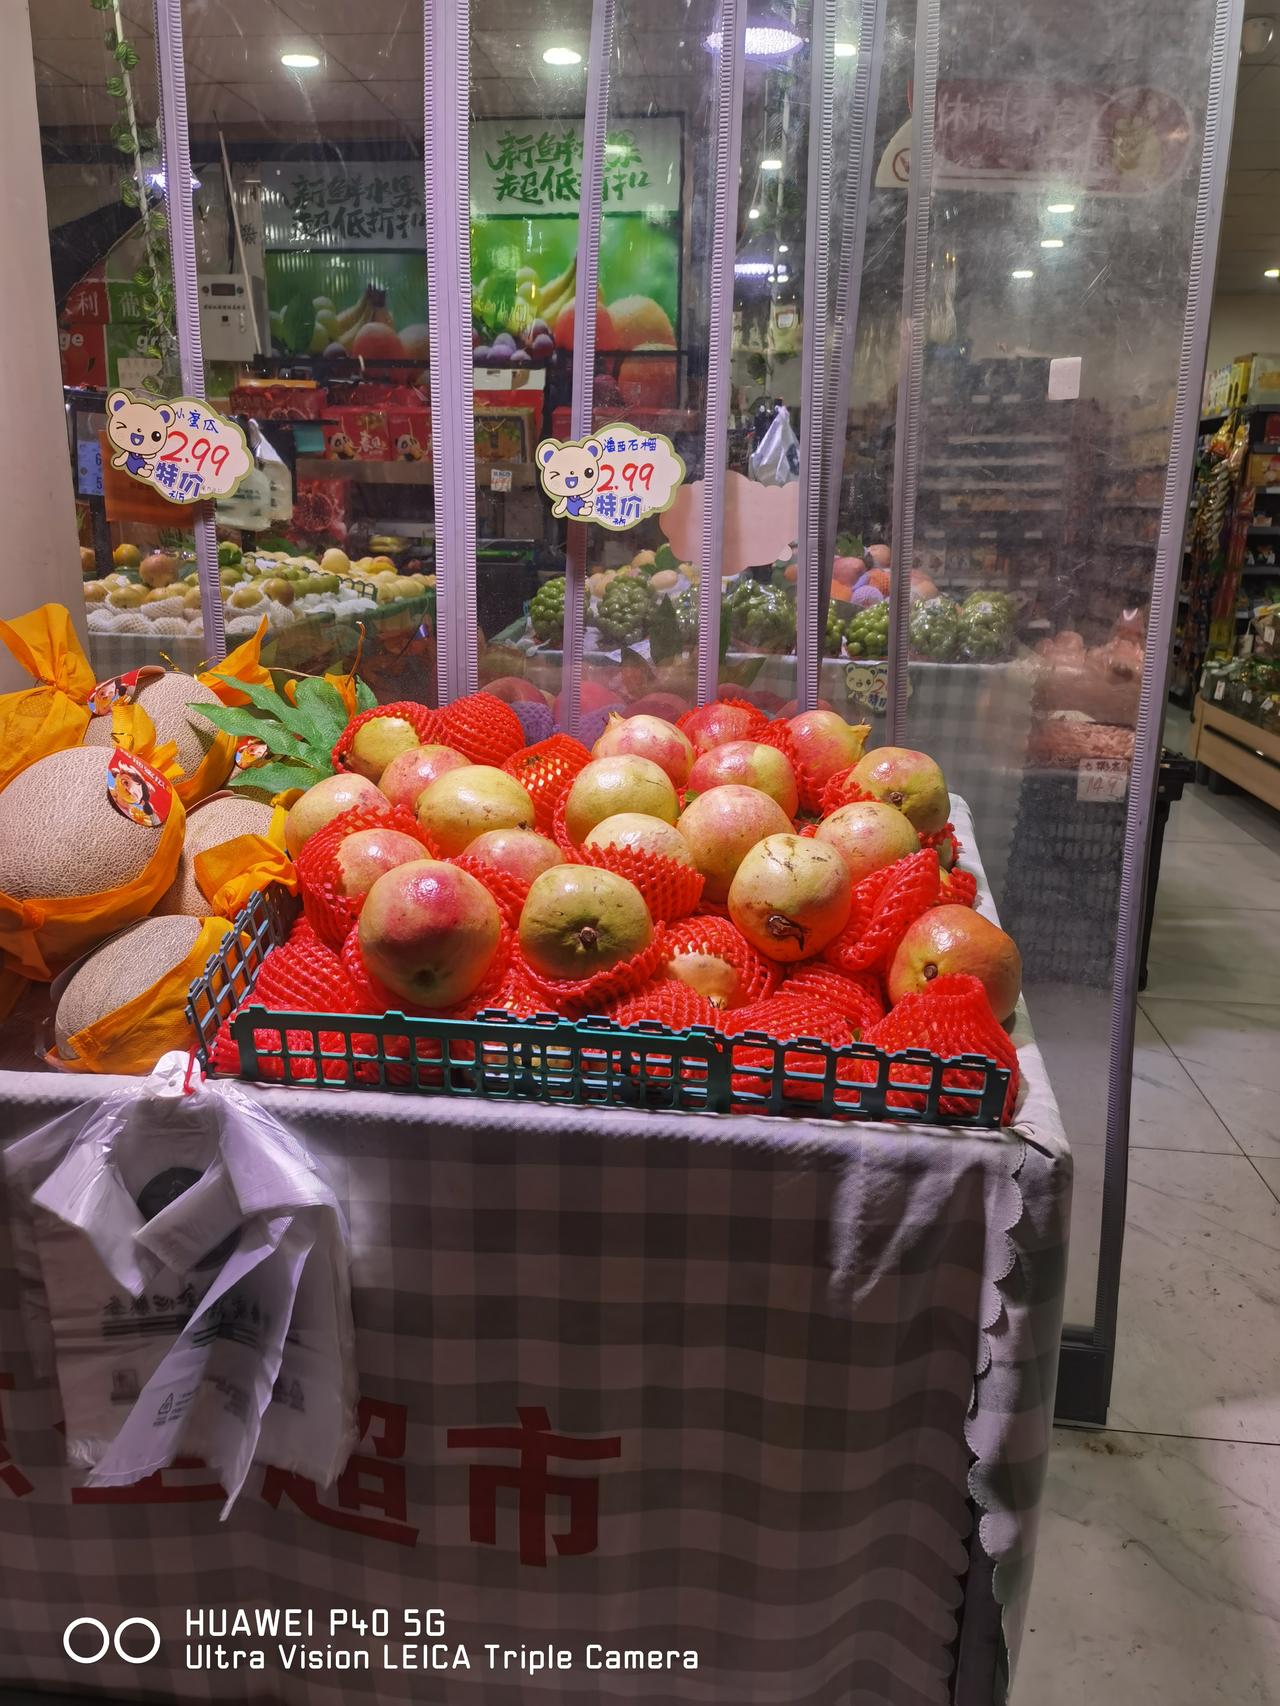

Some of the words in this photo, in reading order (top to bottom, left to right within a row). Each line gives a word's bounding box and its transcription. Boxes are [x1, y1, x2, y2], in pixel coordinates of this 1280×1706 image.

[485, 128, 643, 171] 新鲜果
[160, 430, 230, 476] 2.99
[155, 461, 205, 498] 特价
[596, 462, 655, 493] 2.99
[595, 493, 642, 518] 特价
